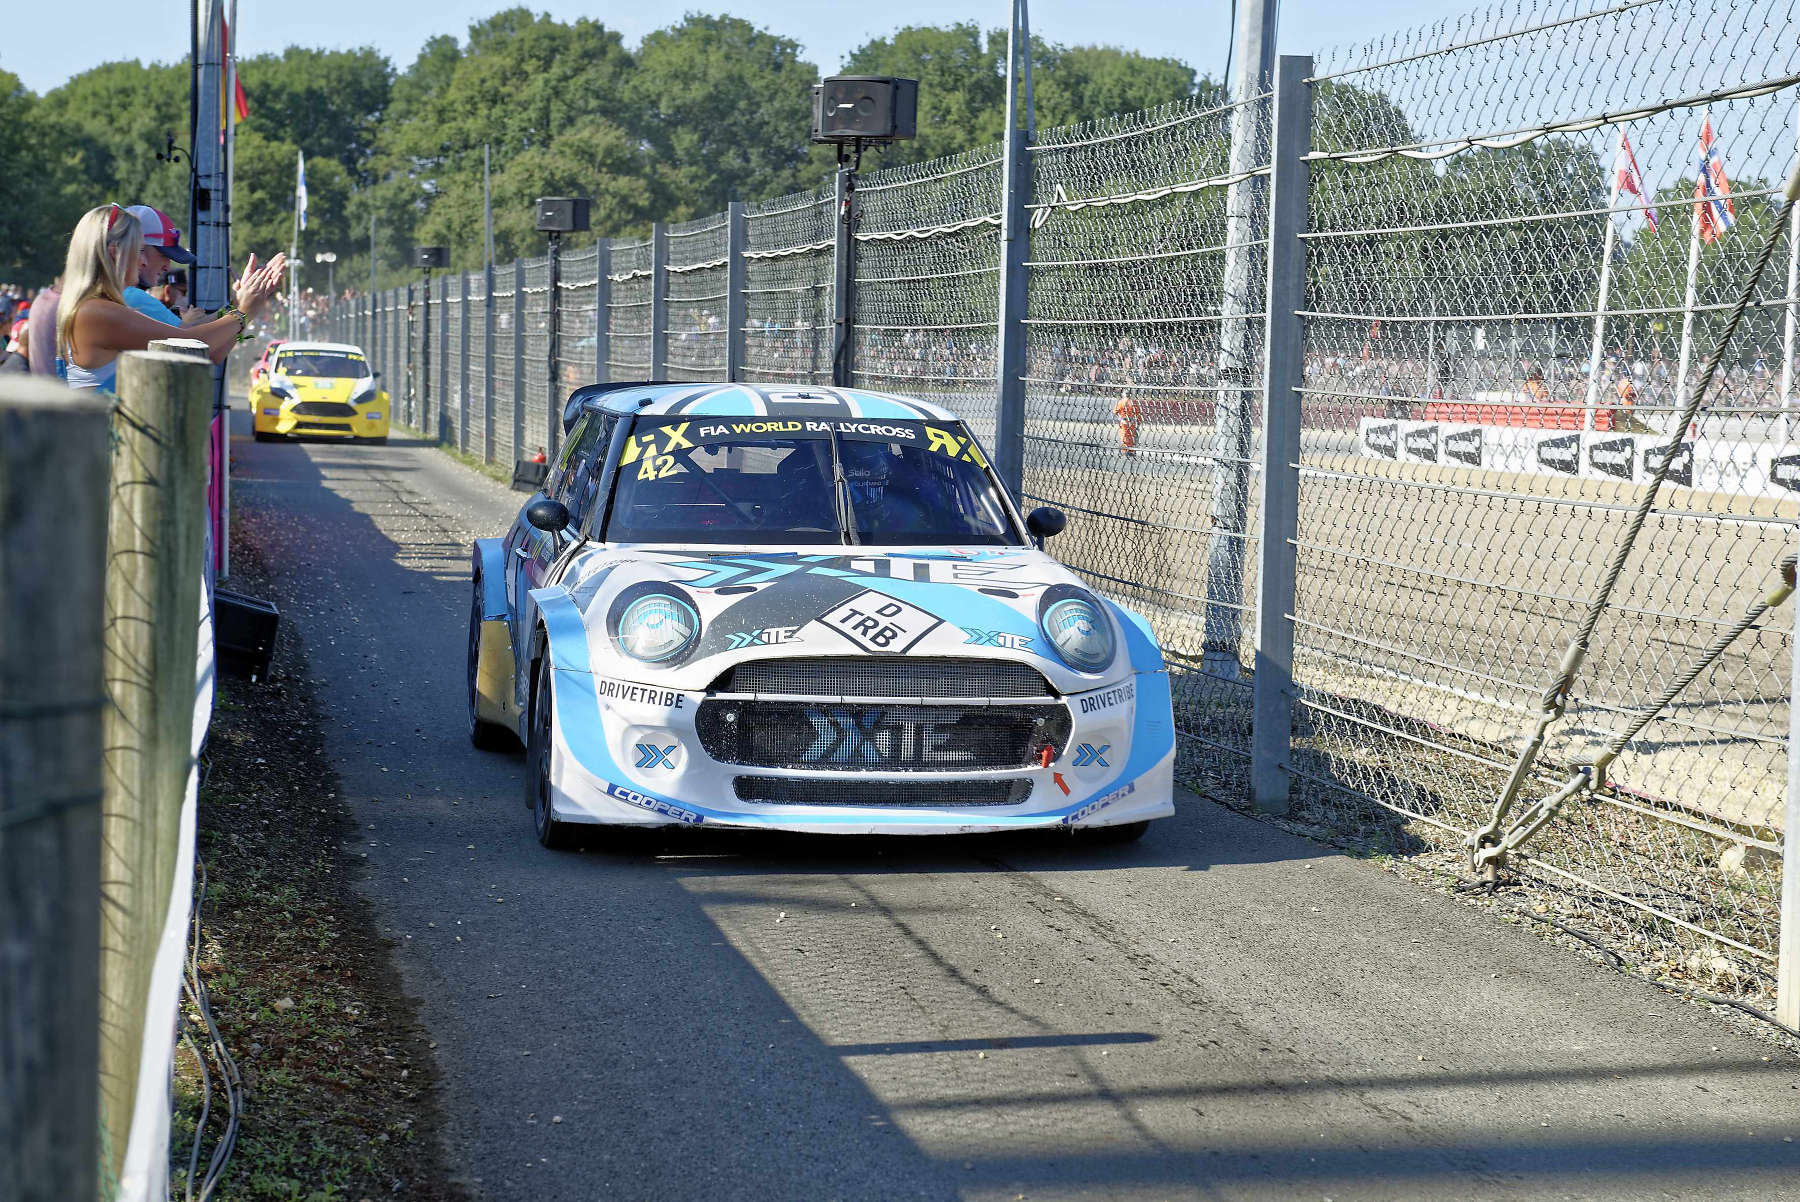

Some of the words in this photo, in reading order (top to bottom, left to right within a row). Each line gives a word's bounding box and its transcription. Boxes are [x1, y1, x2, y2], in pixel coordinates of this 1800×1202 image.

[699, 425, 730, 437] FIA
[731, 421, 802, 434] WORLD
[805, 421, 916, 439] RALLYCROSS
[637, 455, 678, 481] 42
[875, 602, 902, 618] D
[839, 608, 902, 648] TRB
[599, 680, 685, 709] DRIVETRIBE
[1080, 683, 1135, 714] DRIVETRIBE
[614, 786, 697, 823] COOPER
[1068, 785, 1129, 824] COOPER
